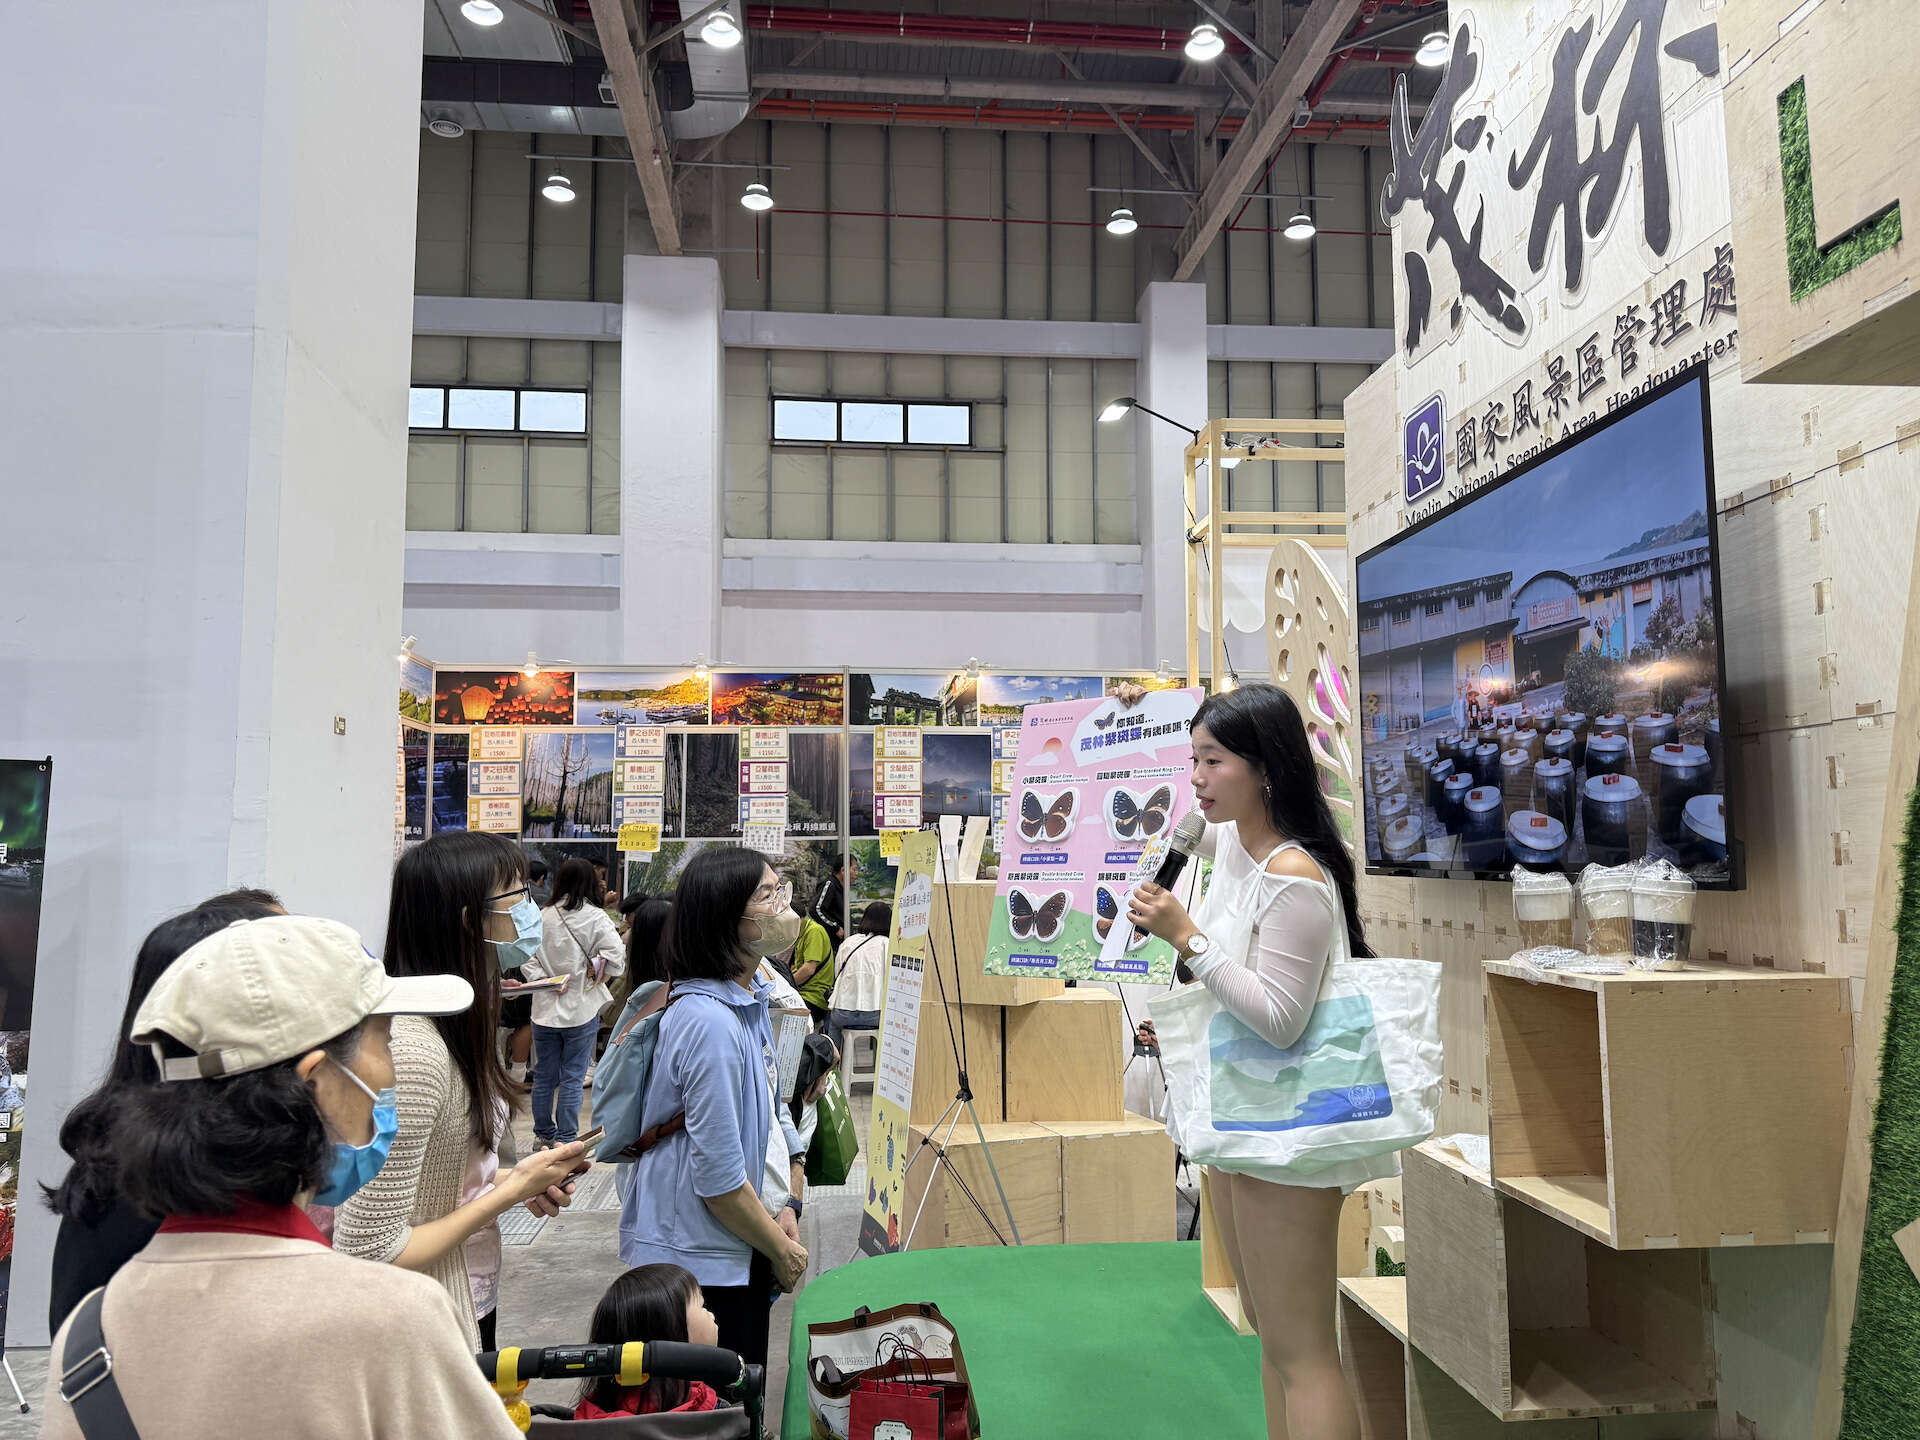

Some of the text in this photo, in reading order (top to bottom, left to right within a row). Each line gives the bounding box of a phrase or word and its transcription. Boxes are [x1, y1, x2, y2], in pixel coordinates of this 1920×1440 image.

[1455, 242, 1737, 474] 國家風景區管理處
[1404, 498, 1442, 528] Maolin
[1447, 463, 1499, 504] National
[1506, 434, 1554, 471] Scenic
[1560, 410, 1597, 440] Area
